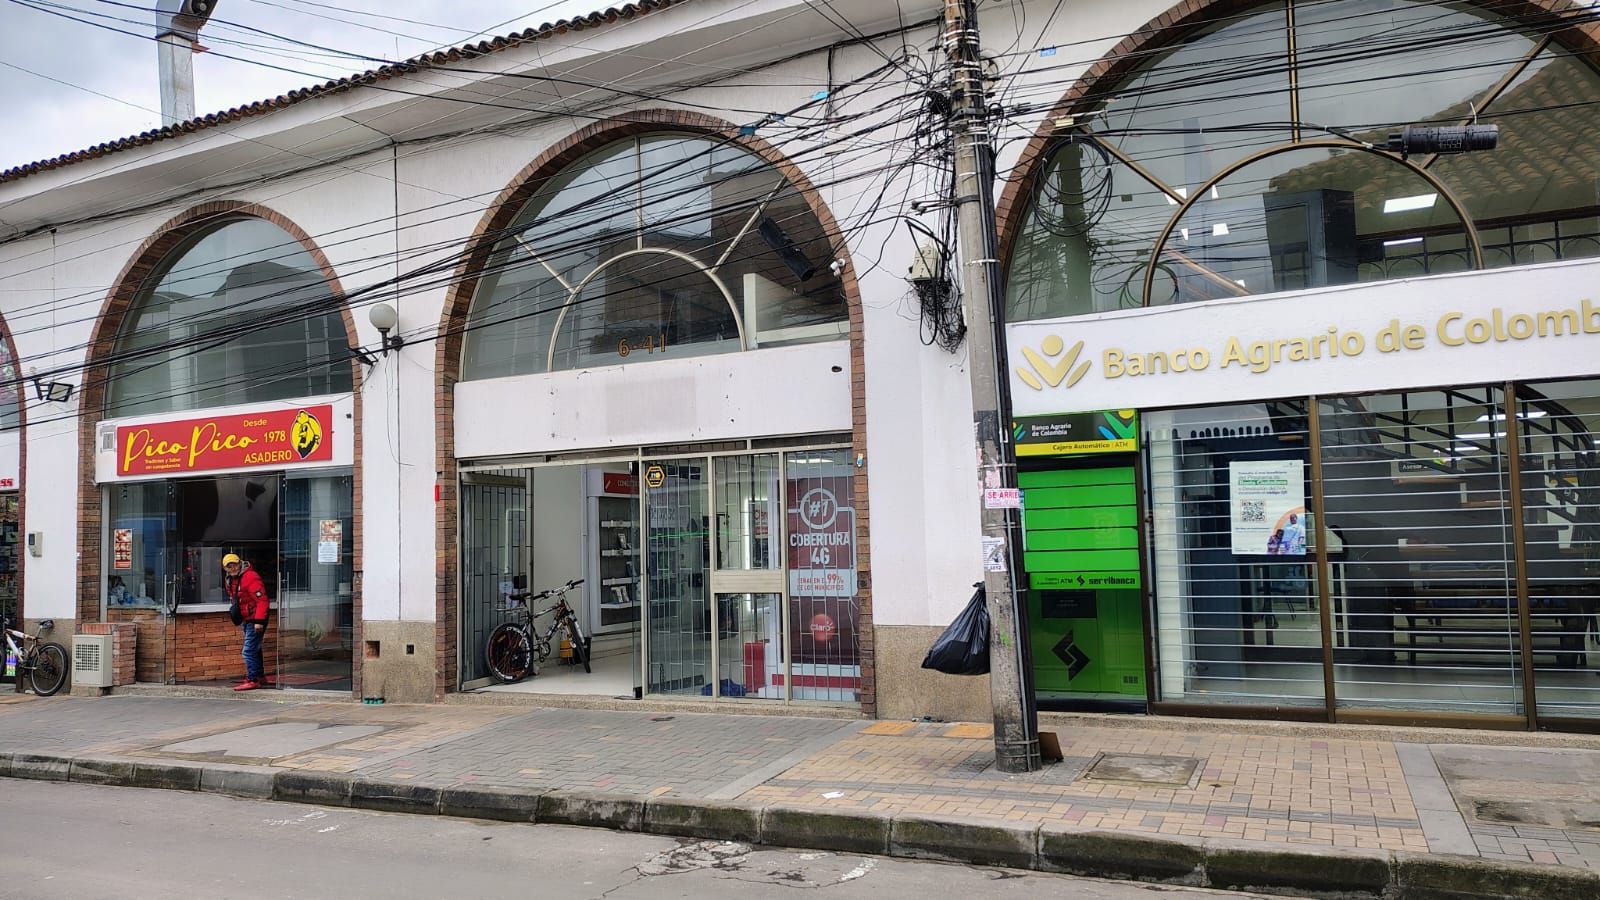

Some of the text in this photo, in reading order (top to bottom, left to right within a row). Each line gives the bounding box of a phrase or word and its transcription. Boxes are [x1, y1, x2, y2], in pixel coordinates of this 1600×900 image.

[1101, 297, 1600, 380] Banco Agrario de Colomb
[243, 418, 268, 428] Desde
[1050, 423, 1072, 432] Agrario
[263, 430, 286, 443] 1978
[123, 422, 258, 471] Pico Pico
[1052, 443, 1073, 452] Cajero
[244, 449, 292, 464] ASADERO
[987, 491, 1019, 499] SE ARRIE
[809, 501, 828, 517] #1
[790, 532, 850, 547] COBERTURA
[811, 547, 830, 565] 4G
[1088, 576, 1136, 585] servibanca
